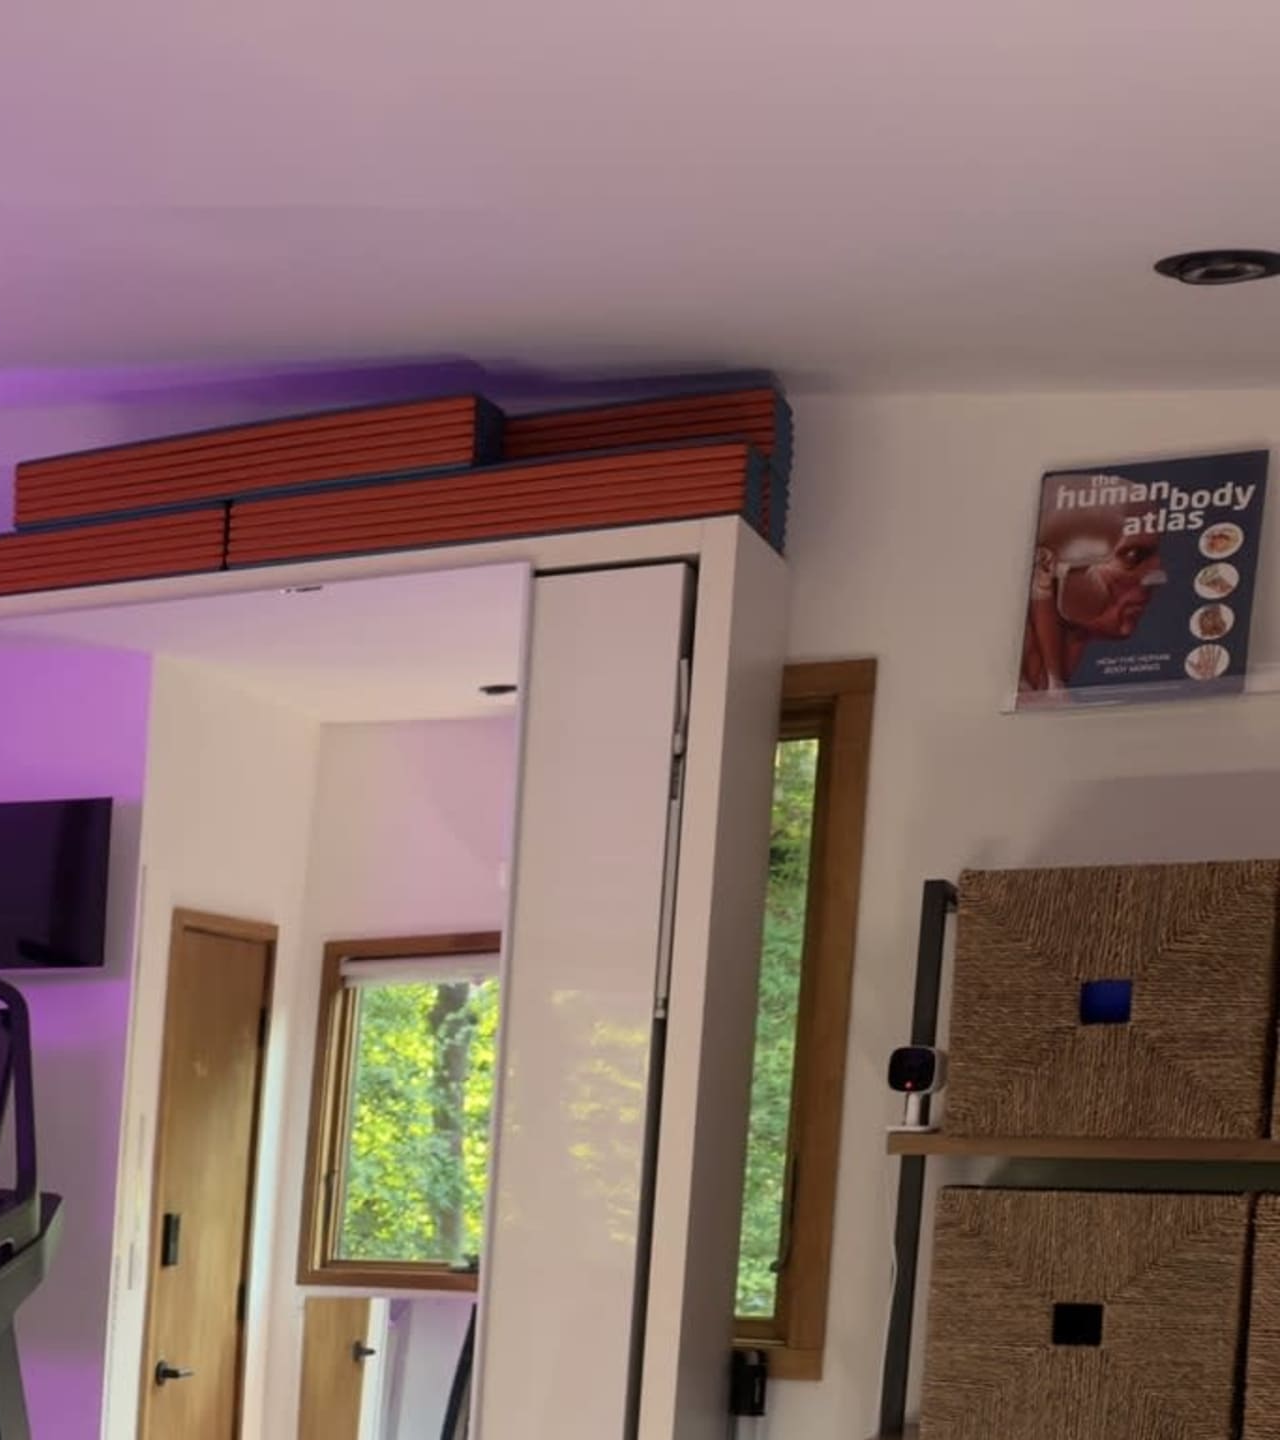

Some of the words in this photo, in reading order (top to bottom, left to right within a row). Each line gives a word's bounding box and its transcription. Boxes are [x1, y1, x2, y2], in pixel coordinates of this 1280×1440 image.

[1091, 474, 1119, 487] the
[1056, 481, 1170, 509] human
[1169, 482, 1255, 510] body
[1122, 510, 1204, 536] atlas
